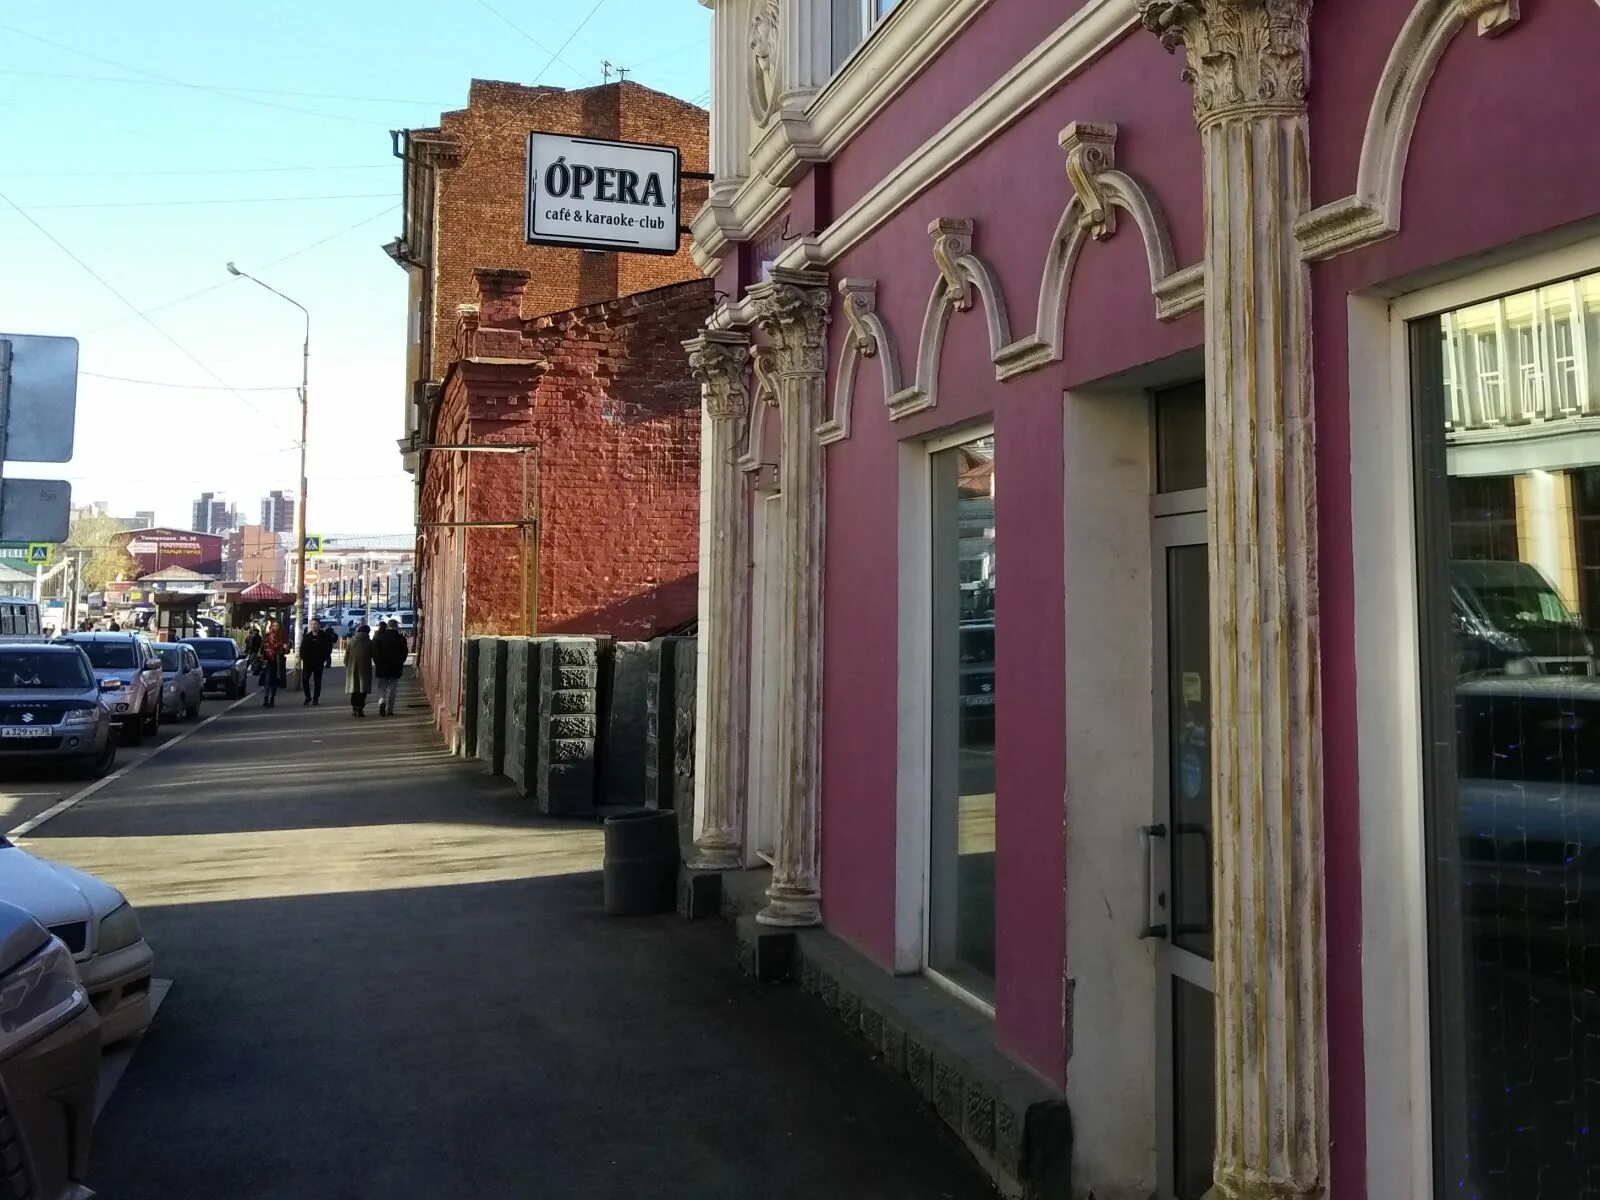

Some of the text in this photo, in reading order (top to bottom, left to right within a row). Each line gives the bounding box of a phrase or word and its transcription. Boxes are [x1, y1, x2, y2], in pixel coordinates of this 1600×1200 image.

[544, 156, 666, 207] ÓPERA
[545, 207, 665, 230] café & karaoke-club
